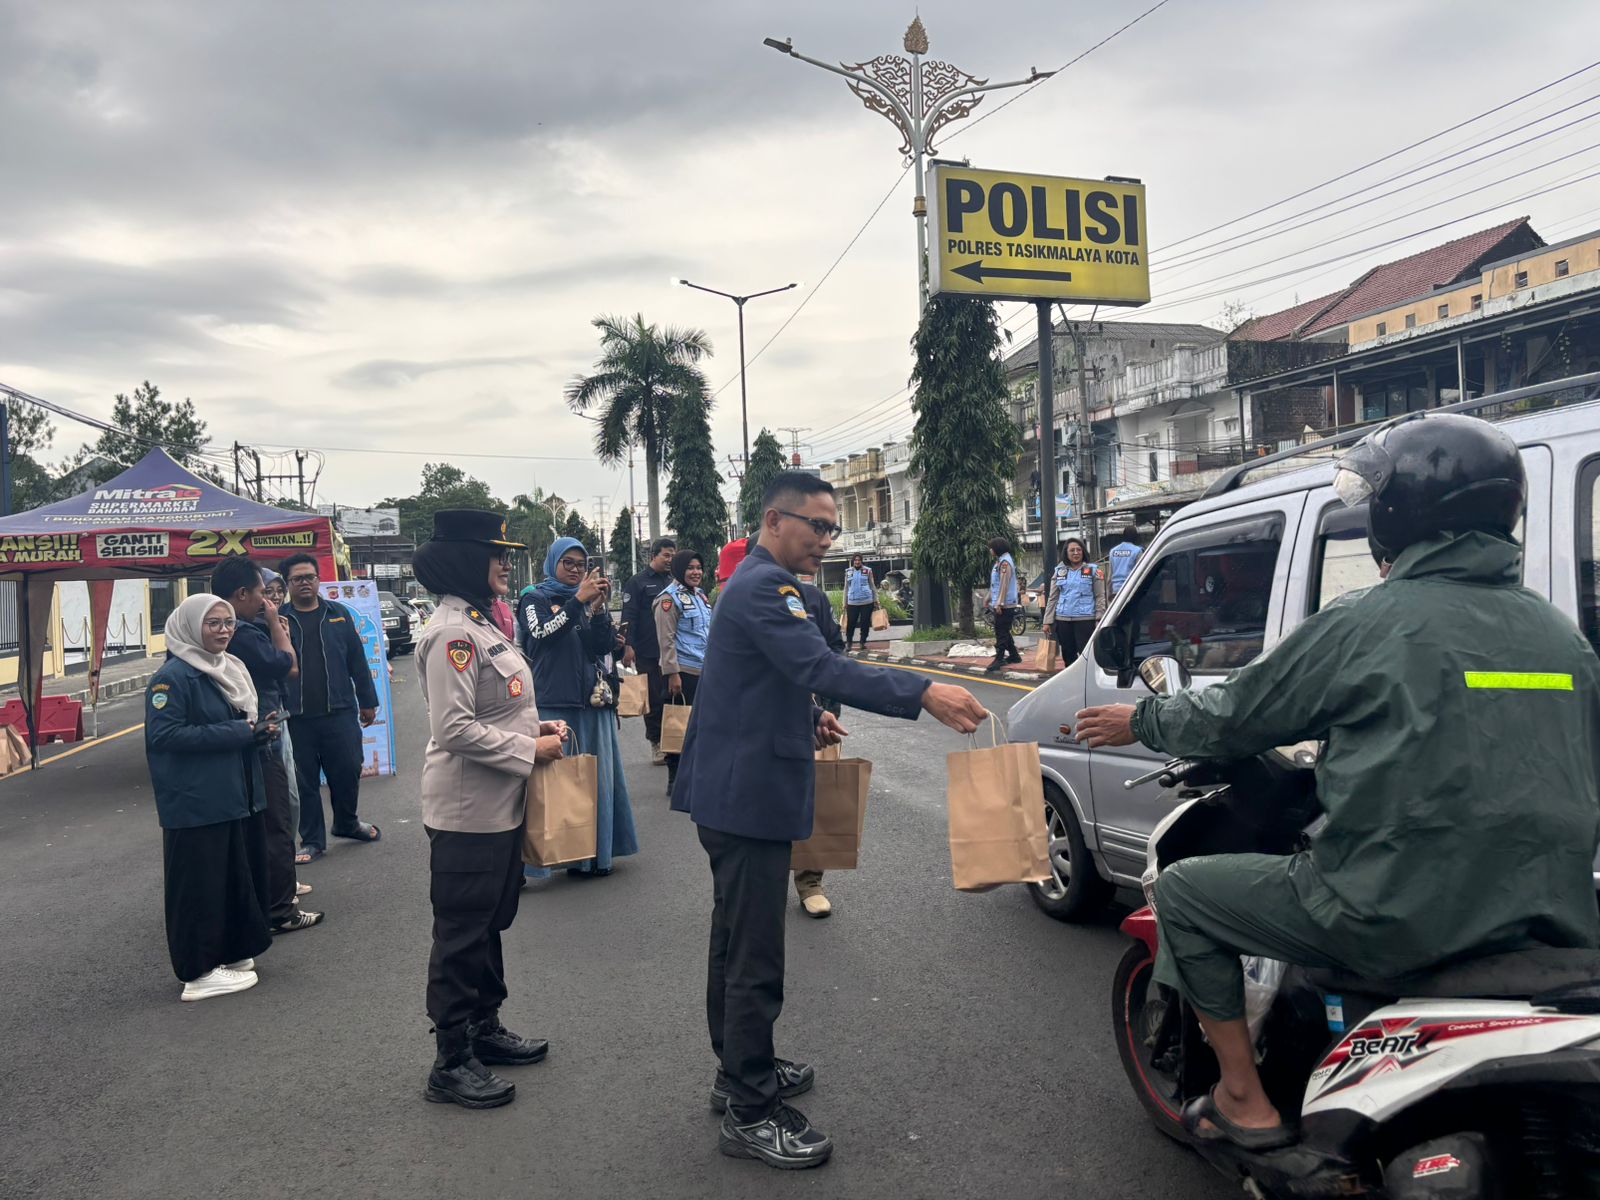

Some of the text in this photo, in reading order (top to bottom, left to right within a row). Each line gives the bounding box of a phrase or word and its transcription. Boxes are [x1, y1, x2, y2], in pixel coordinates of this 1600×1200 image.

[946, 178, 1139, 246] POLISI
[948, 239, 1140, 265] POLRES TASIKMALAYA KOTA
[90, 500, 199, 510] SUPERMARKET
[104, 534, 162, 547] GANTI
[186, 529, 250, 556] 2X
[14, 550, 81, 563] MURAH
[100, 545, 165, 557] SELISIH
